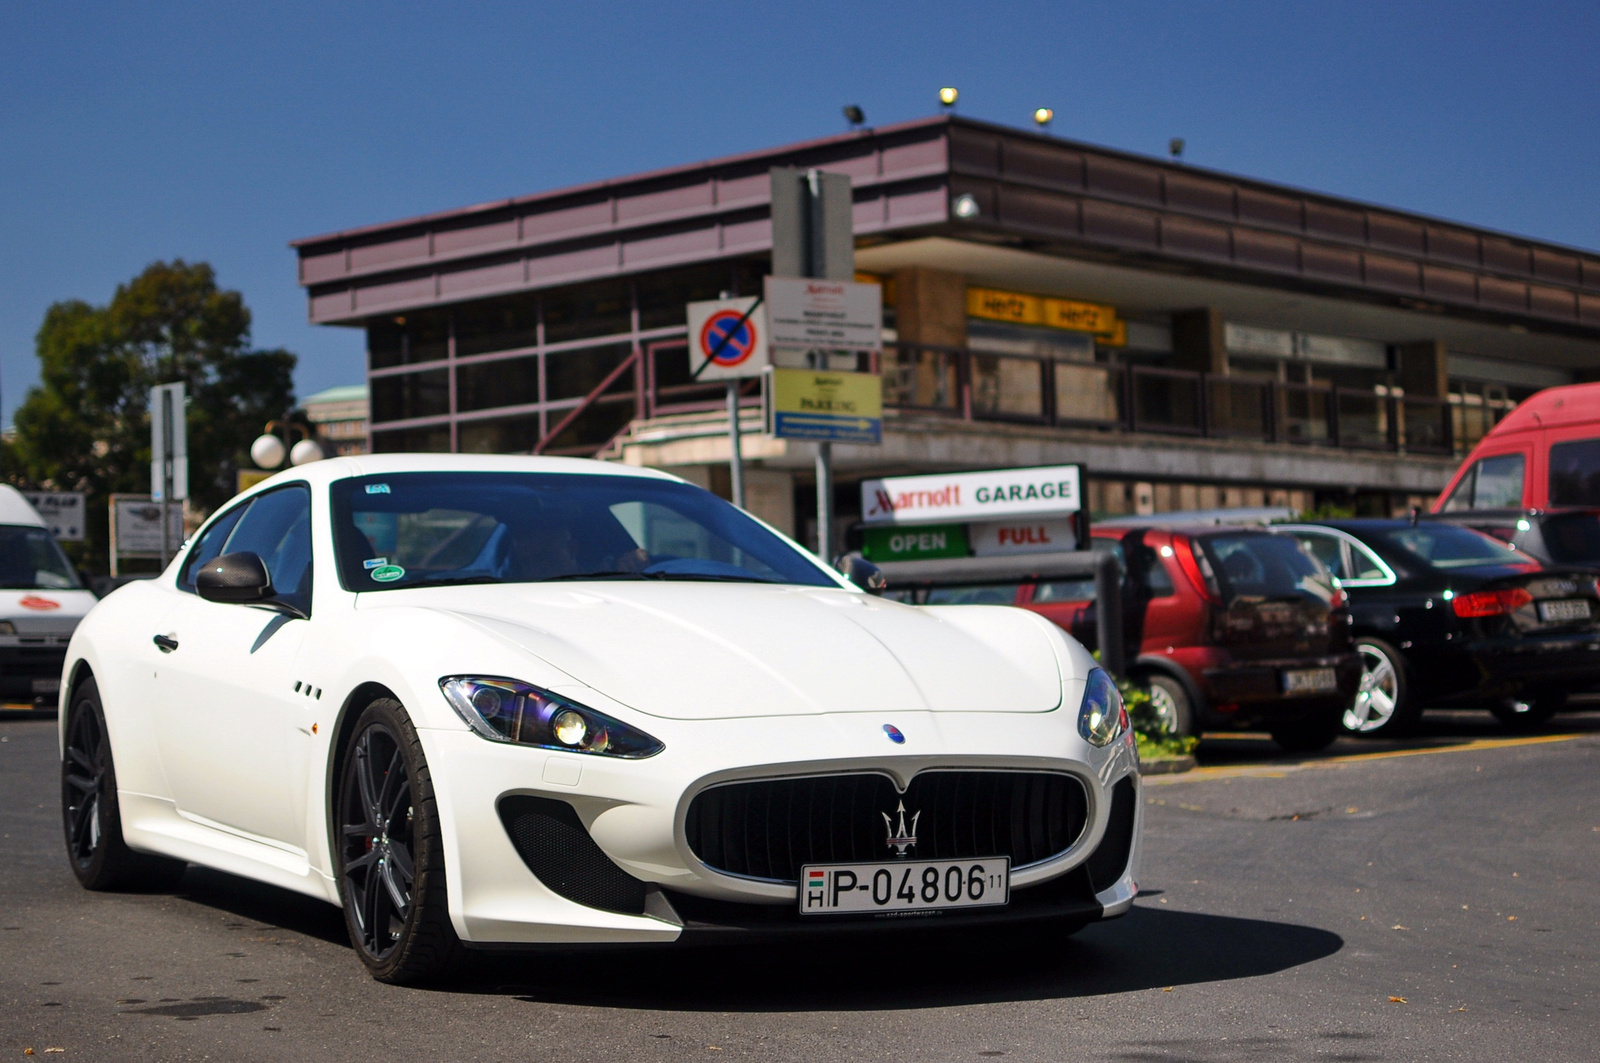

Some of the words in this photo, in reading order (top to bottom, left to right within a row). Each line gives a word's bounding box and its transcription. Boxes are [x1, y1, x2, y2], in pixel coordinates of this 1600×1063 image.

[869, 485, 960, 515] Marriott
[976, 481, 1071, 503] GARAGE
[890, 533, 946, 552] OPEN
[998, 527, 1048, 545] FULL
[832, 865, 986, 907] P-04806
